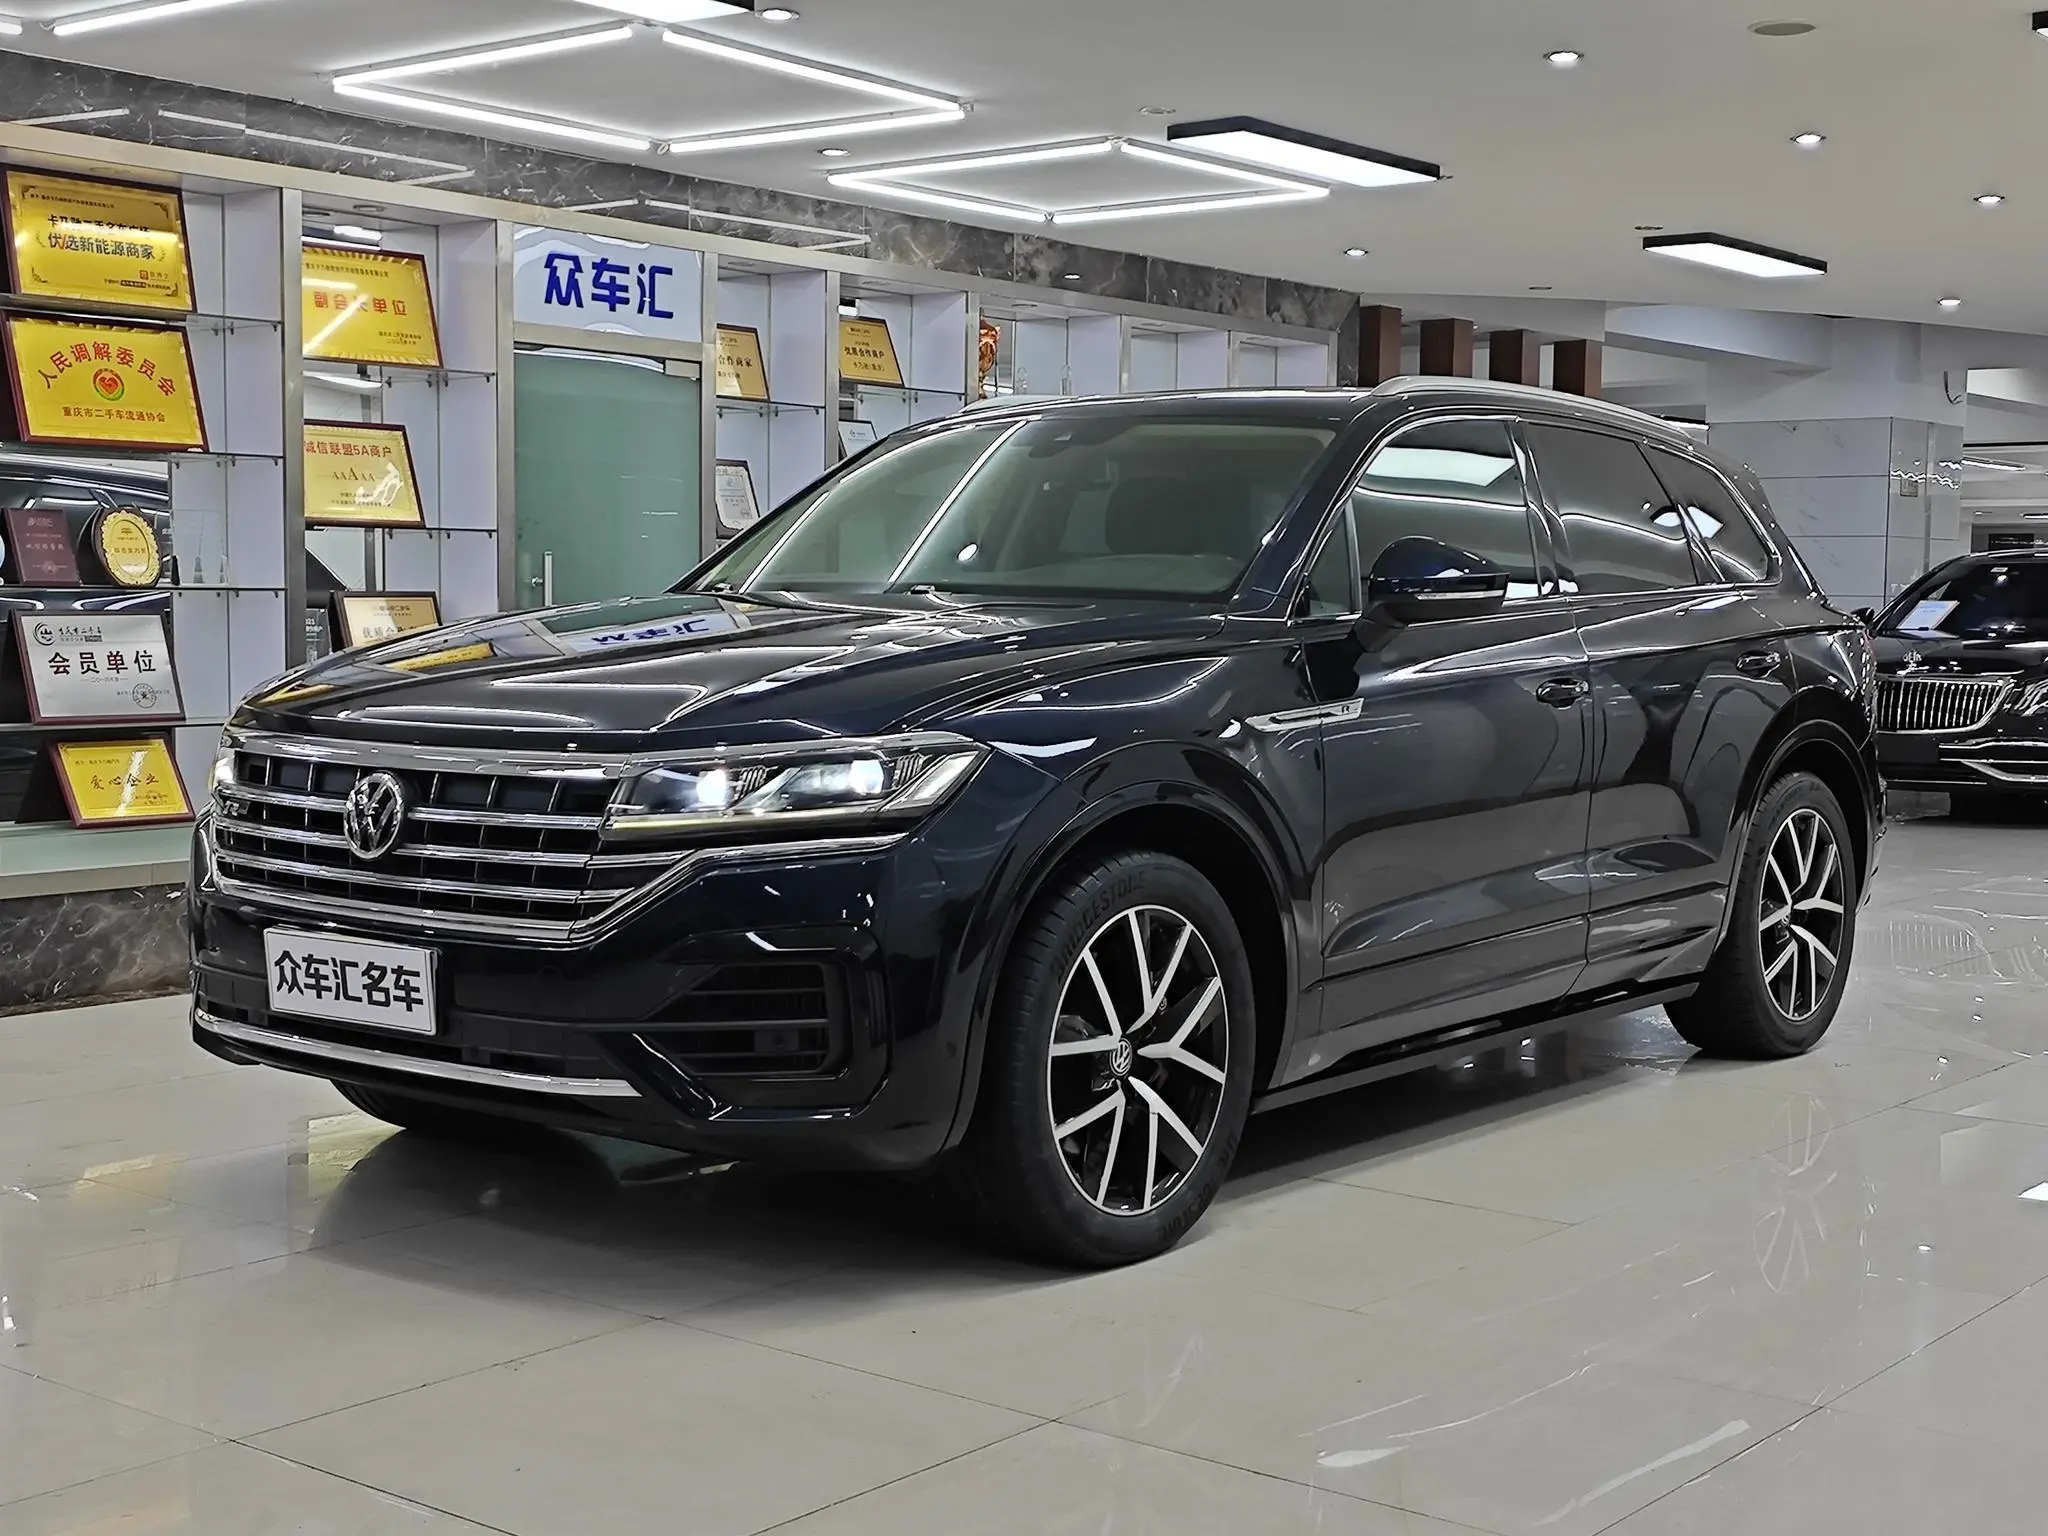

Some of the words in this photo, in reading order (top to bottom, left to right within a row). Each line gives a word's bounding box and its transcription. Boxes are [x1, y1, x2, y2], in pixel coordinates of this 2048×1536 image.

[544, 250, 674, 319] 众车汇
[38, 340, 176, 397] 人民调解委员会
[62, 405, 166, 422] 重庆市二手车流通协会
[48, 649, 157, 675] 会员单位
[90, 773, 159, 790] 爱心企业
[273, 950, 424, 1012] 众车汇名车
